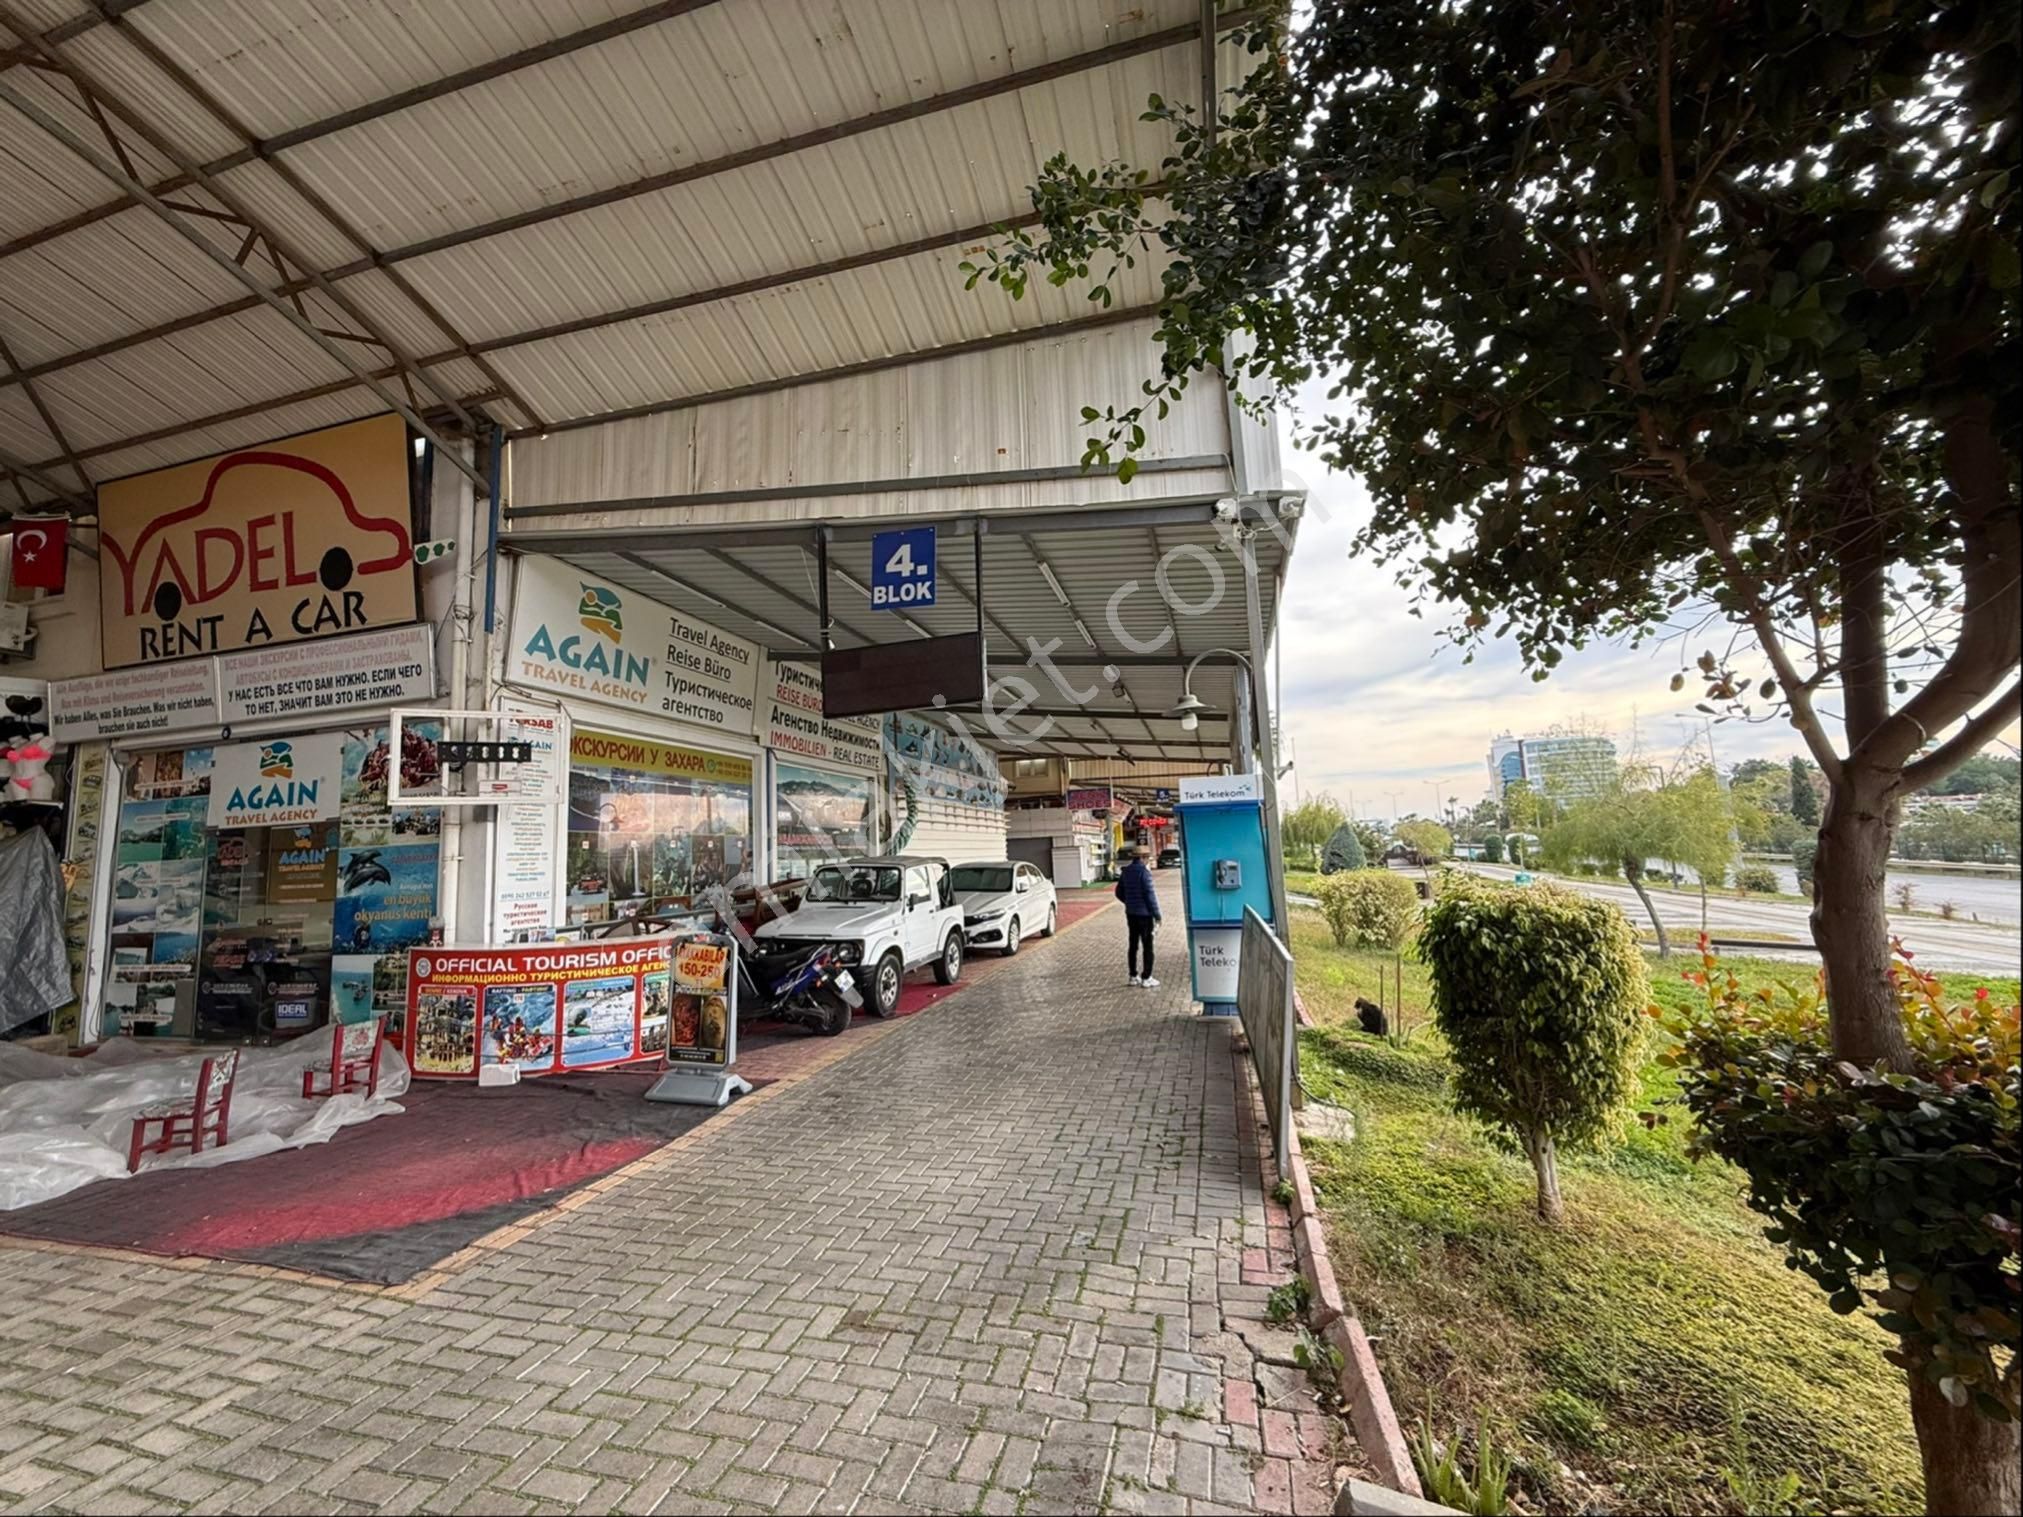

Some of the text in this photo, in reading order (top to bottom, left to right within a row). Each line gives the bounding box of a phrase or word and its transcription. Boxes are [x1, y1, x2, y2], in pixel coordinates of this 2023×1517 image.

[102, 511, 317, 617] YADEL
[885, 543, 928, 577] 4.
[873, 581, 933, 605] BLOK
[139, 591, 367, 660] RENT A CAR
[669, 617, 750, 662] Travel Agency
[525, 623, 650, 687] AGAIN
[666, 644, 731, 680] Reise Büro
[228, 663, 422, 703] У НАС ЕСТЬ ВСЕ ЧТО ВАМ НУЖНО. ЕСЛИ ЧЕГО
[521, 661, 648, 704] TRAVEL AGENCY
[665, 671, 753, 711] Туристическое
[777, 684, 801, 705] REISE
[54, 715, 63, 726] Wir
[65, 714, 81, 724] haben
[100, 709, 112, 719] was
[113, 707, 122, 718] Sie
[153, 702, 166, 713] Was
[167, 700, 176, 711] wir
[178, 698, 193, 710] nicht
[245, 684, 405, 716] ТО НЕТ, ЗНАЧИТ ВАМ ЭТО НЕ НУЖНО.
[662, 697, 724, 724] агентство
[98, 721, 125, 734] brauchen
[126, 719, 135, 730] sie
[136, 718, 151, 729] auch
[771, 704, 819, 735] Агенство
[650, 749, 659, 765] У
[665, 751, 706, 772] ЗАХАРА
[770, 731, 827, 756] IMMOBILIEN
[833, 746, 852, 762] REAL
[854, 751, 880, 769] ESTATE
[226, 780, 318, 812] AGAIN
[1184, 790, 1245, 800] Türk Telekom
[225, 809, 318, 825] TRAVEL AGENCY
[279, 849, 326, 864] AGAIN
[354, 908, 401, 923] okyanus
[435, 957, 518, 973] OFFICIAL
[522, 951, 617, 971] TOURISM
[1199, 945, 1224, 955] Türk
[1200, 957, 1237, 967] Teleko
[432, 973, 527, 984] ИНФОРМАЦИОННО
[278, 1004, 307, 1014] IDEAL
